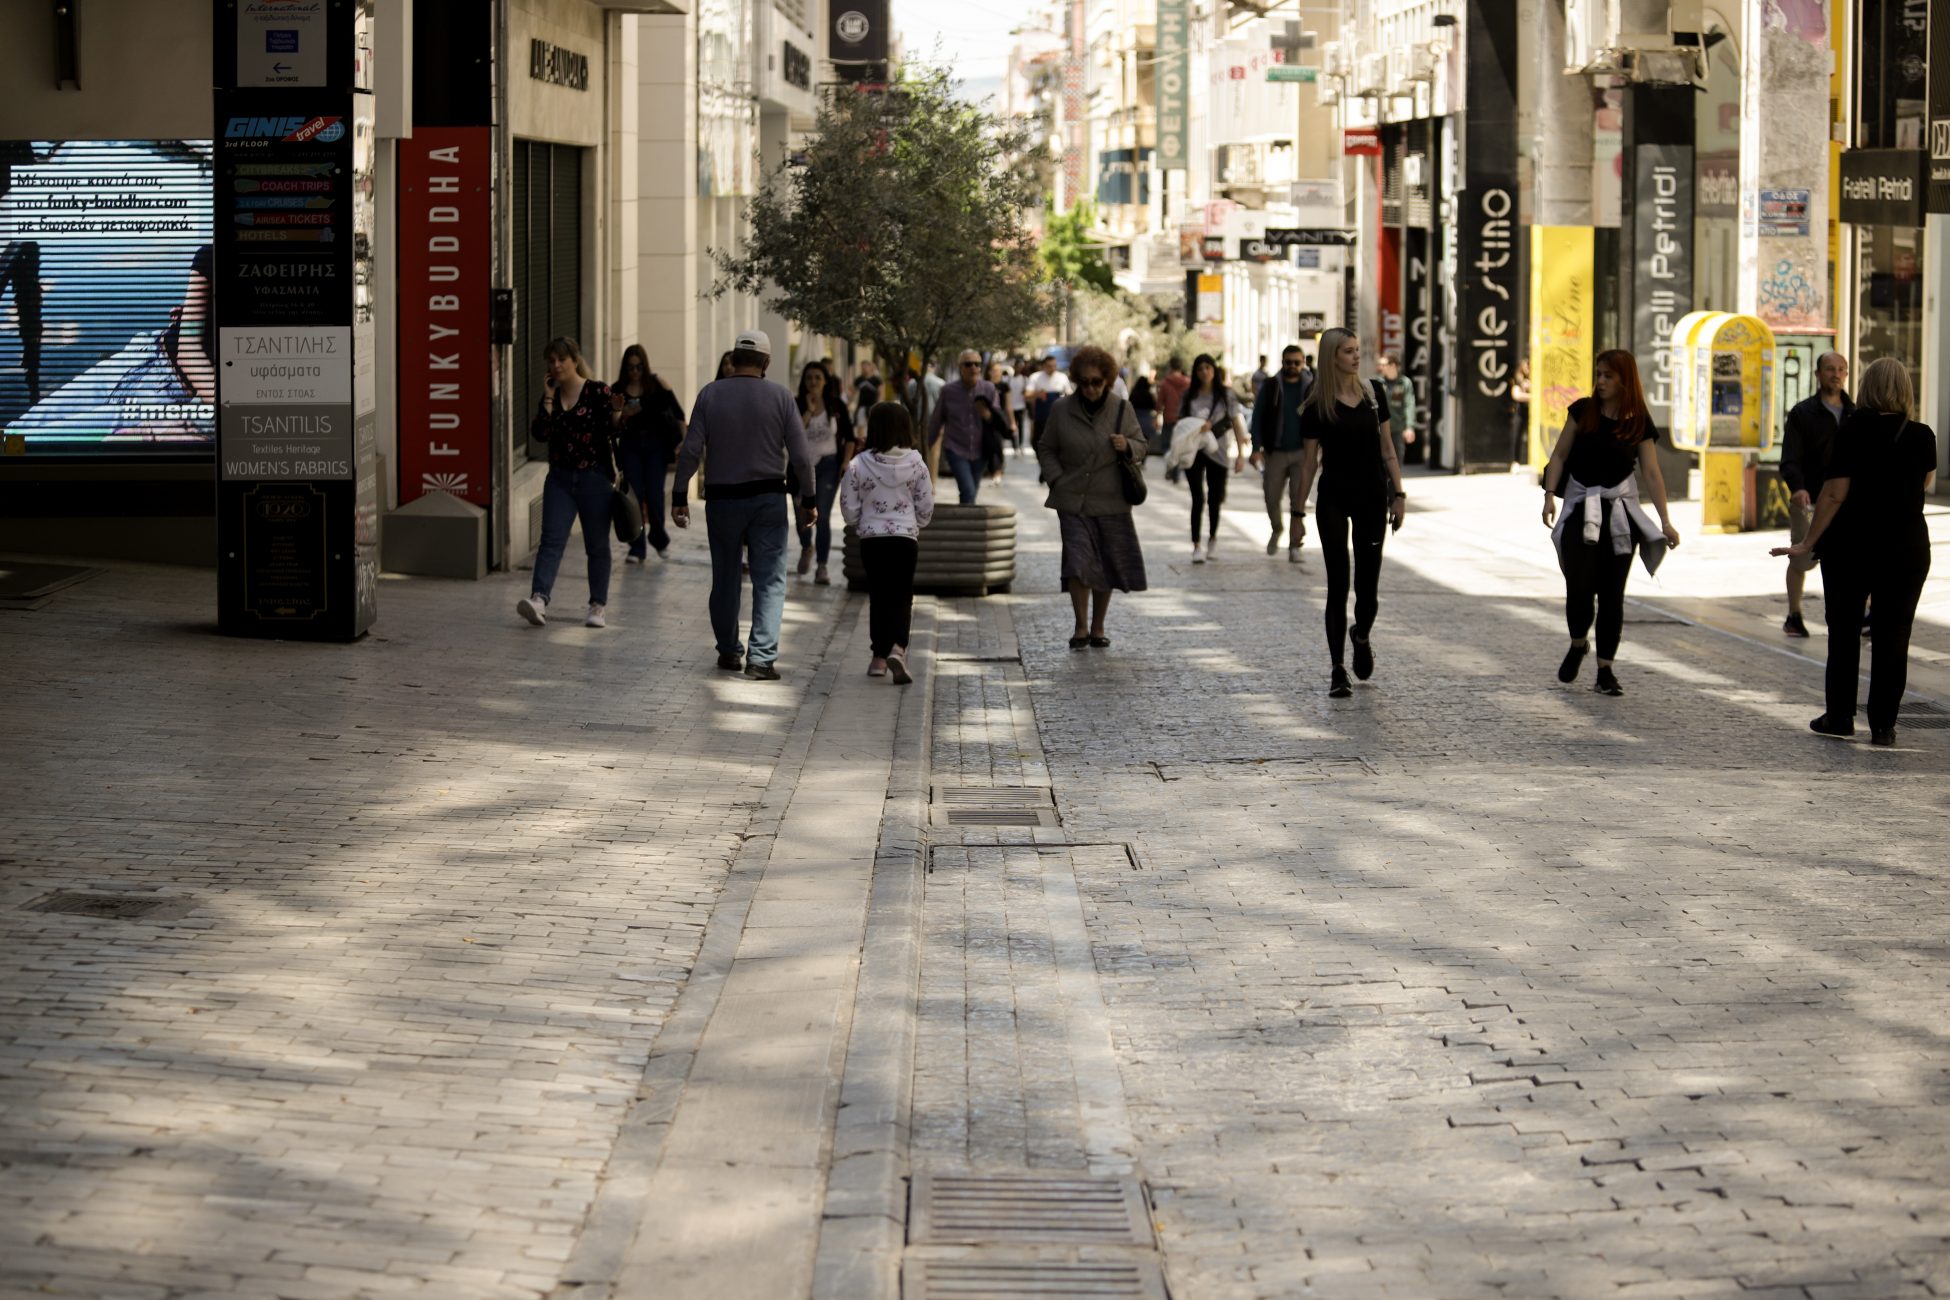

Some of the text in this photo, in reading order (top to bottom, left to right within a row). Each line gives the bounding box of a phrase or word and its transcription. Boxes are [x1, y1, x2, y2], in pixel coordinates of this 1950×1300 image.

[224, 116, 325, 142] GINIS travel
[225, 140, 269, 148] 3rd FLOOR
[261, 181, 330, 191] COACH TRIPS
[1842, 176, 1913, 201] Fratelli Petridi
[267, 197, 305, 208] CRUISES
[288, 214, 331, 224] TICKETS
[1651, 165, 1677, 279] Petridi
[239, 230, 288, 241] HOTELS
[1266, 230, 1358, 243] VANITY
[238, 263, 336, 278] ΖΑΦΕΙΡΗΣ
[254, 285, 320, 295] ΥΦΑΣΜΑΤΑ
[429, 146, 460, 456] FUNKYBUDDHA
[233, 336, 337, 354] ΤΣΑΝΤΙΛΗΣ
[250, 364, 321, 380] υφάσματα
[256, 389, 316, 399] ΕΝΤΟΣ ΣΤΟΑΣ
[241, 415, 332, 434] TSANTILIS
[252, 444, 321, 455] Textiles Heritage
[226, 460, 349, 476] WOMEN'S FABRICS
